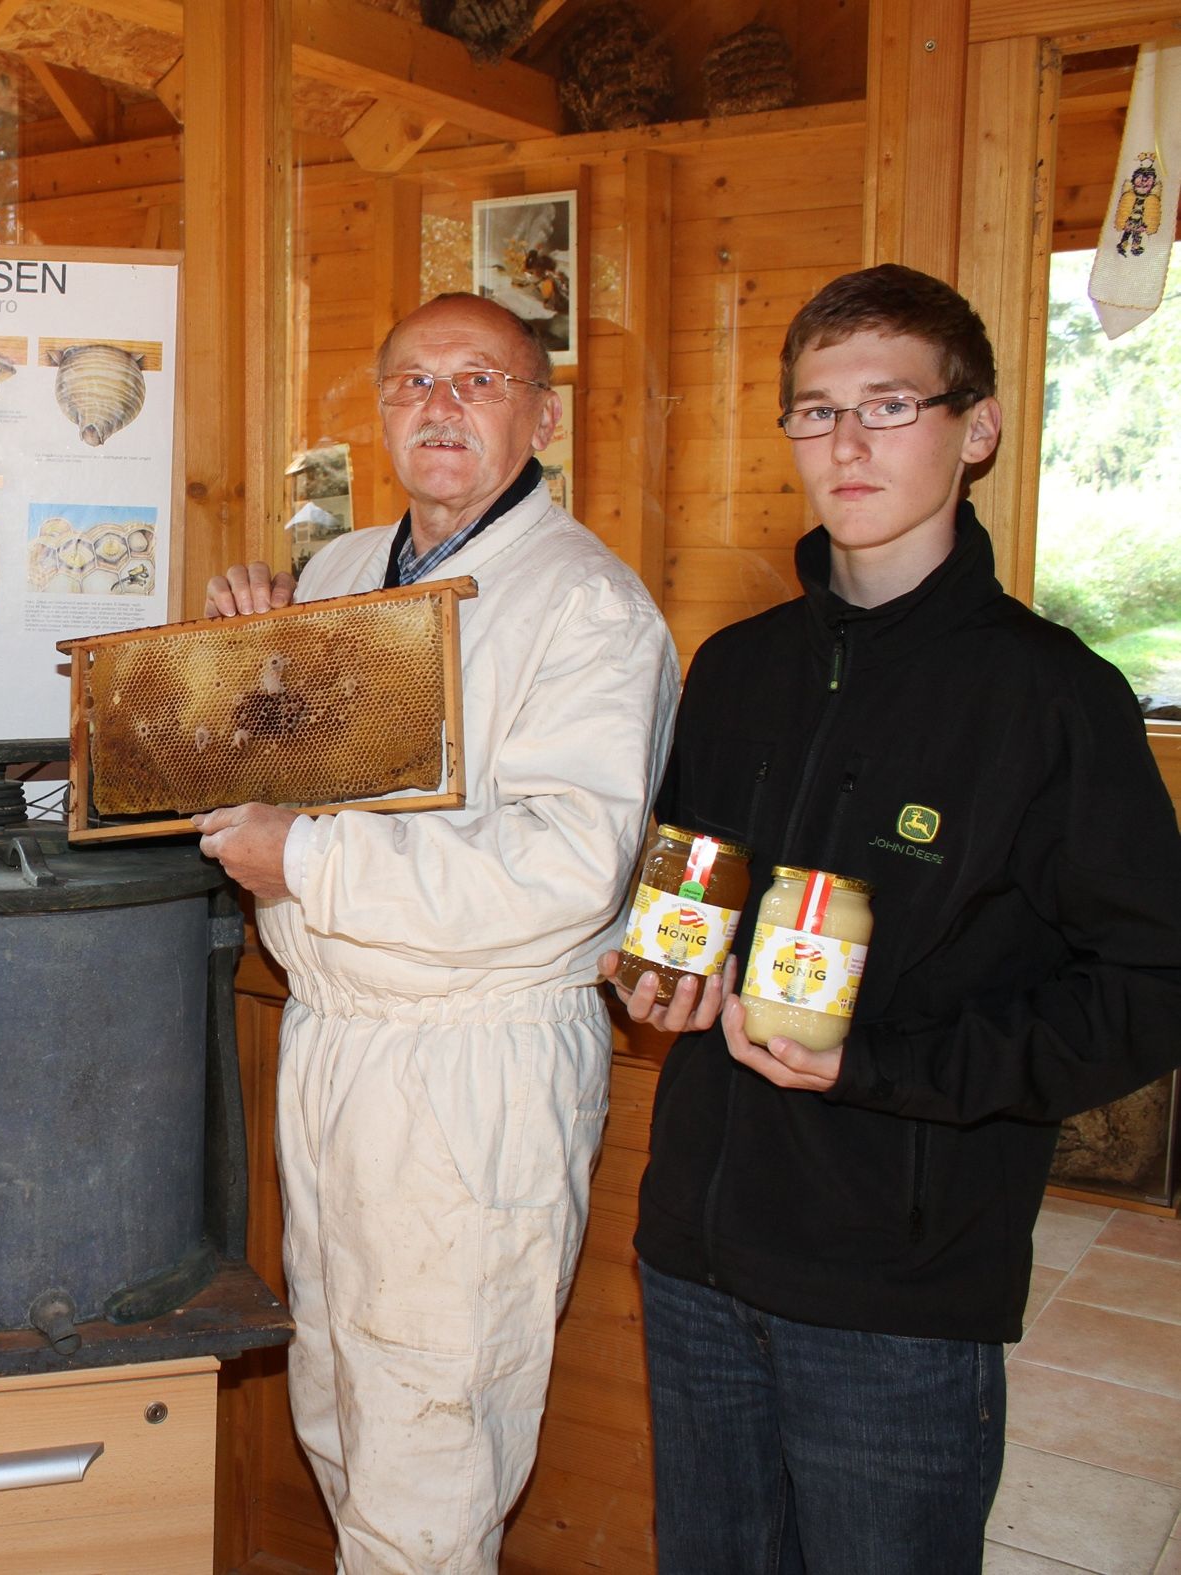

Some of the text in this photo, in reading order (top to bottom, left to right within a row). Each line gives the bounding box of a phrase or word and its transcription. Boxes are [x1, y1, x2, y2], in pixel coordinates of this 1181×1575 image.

[868, 835, 945, 865] JOHN DEERE
[657, 923, 707, 946] HONIG
[772, 959, 827, 981] HONIG
